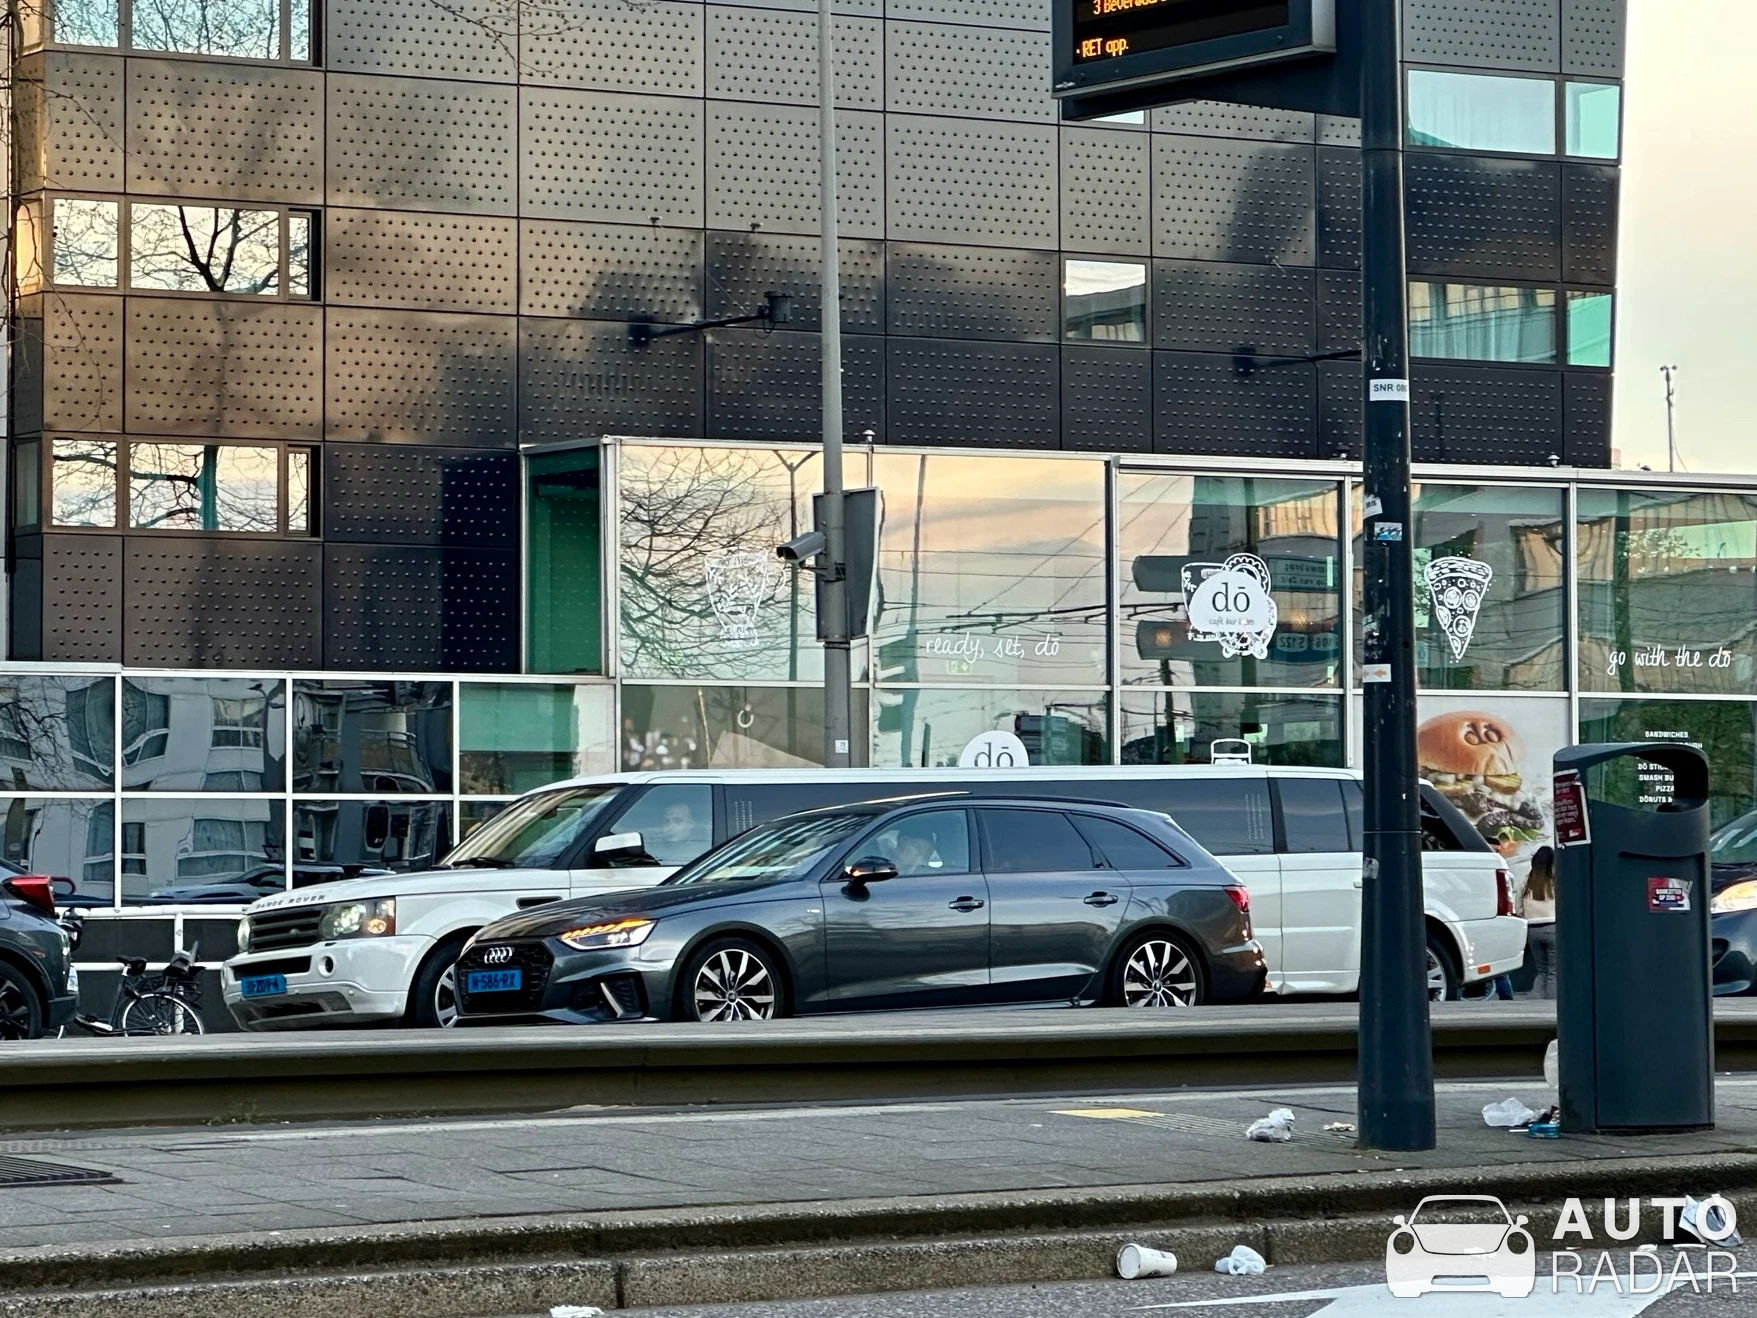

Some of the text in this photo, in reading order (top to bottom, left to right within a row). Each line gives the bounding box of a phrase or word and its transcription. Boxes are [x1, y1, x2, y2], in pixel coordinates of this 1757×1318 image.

[1082, 37, 1129, 58] RET app.
[1373, 383, 1394, 392] SNR
[1211, 582, 1251, 613] dō
[925, 632, 1061, 663] ready, set, dō
[1607, 644, 1732, 676] go with the dō
[1464, 722, 1503, 745] dō
[1645, 730, 1689, 738] SANDWICHES
[974, 741, 1014, 767] dō
[1638, 774, 1663, 782] SMASH
[1655, 785, 1675, 793] PIZZA
[288, 895, 326, 904] ROVER
